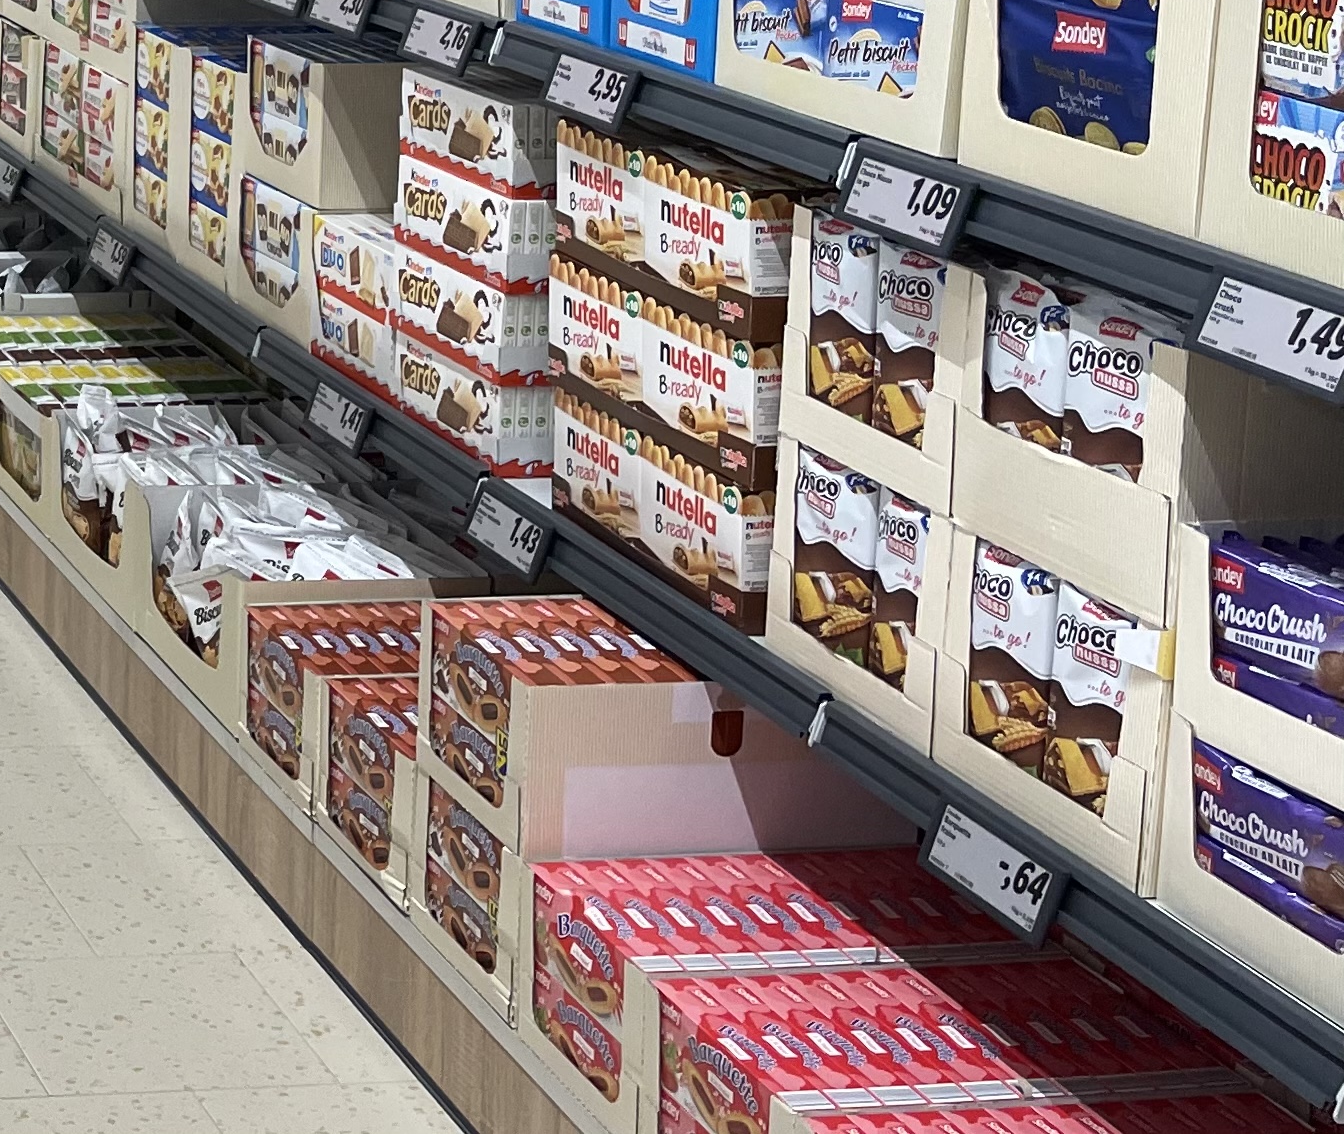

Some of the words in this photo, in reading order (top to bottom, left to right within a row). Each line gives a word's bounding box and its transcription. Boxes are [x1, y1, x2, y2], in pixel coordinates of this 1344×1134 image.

[439, 21, 469, 50] 2,16
[1263, 8, 1333, 53] CROCK
[588, 68, 626, 104] 2,95
[409, 95, 451, 134] Cards
[569, 159, 623, 202] nutella
[906, 177, 957, 220] 1,09
[660, 199, 724, 246] nutella
[730, 199, 746, 214] x10
[660, 233, 701, 261] B-ready
[1069, 343, 1143, 377] Choco
[1094, 370, 1136, 396] nussa
[511, 515, 541, 556] 1,43
[1234, 631, 1274, 654] CHOCOLAT
[1275, 643, 1289, 656] AU
[1290, 646, 1315, 666] LAIT
[556, 912, 615, 979] Barquette
